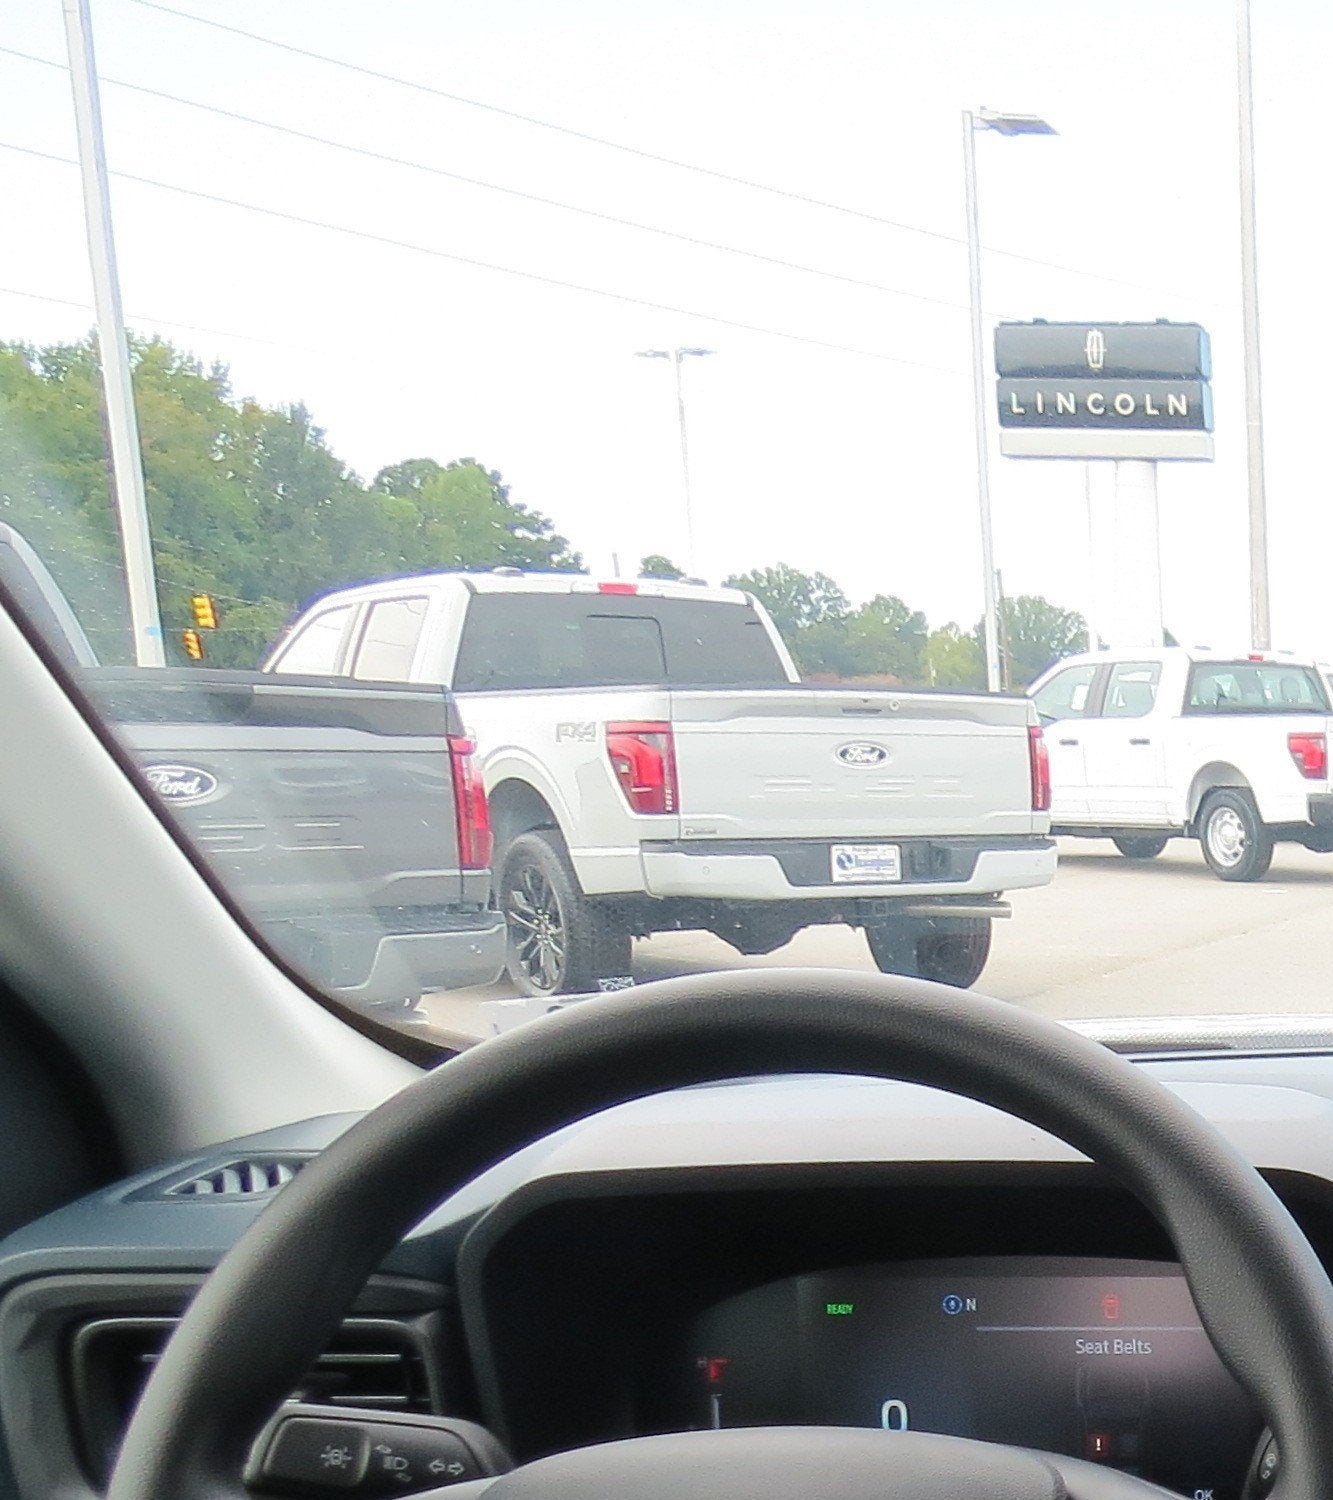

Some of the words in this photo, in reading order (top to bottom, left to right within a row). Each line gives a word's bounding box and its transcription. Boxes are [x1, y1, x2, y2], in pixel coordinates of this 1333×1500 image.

[1010, 391, 1188, 416] LINCOLN
[826, 1304, 854, 1315] READY
[965, 1298, 977, 1311] N
[1075, 1338, 1109, 1355] Seat
[1114, 1338, 1152, 1355] Belts
